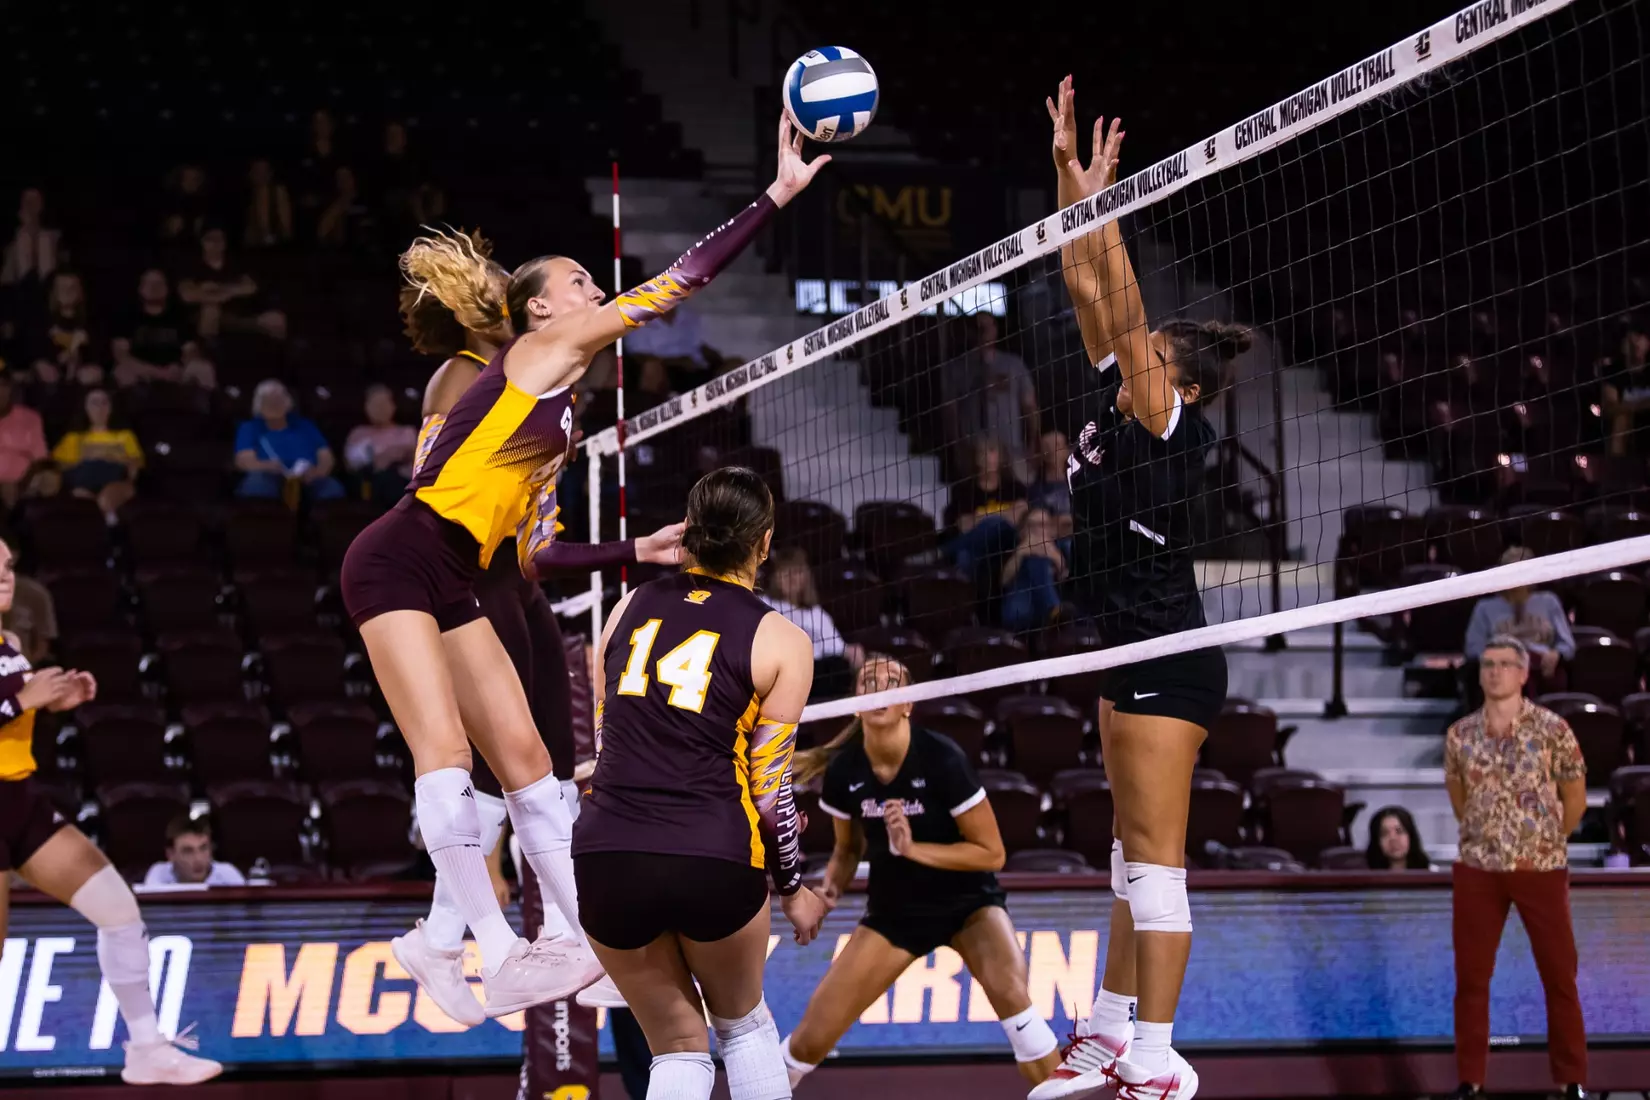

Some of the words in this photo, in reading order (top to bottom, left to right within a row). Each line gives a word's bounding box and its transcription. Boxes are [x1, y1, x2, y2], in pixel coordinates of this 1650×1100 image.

[1455, 0, 1508, 43] CENTRAL
[1235, 112, 1277, 150] CENTRAL
[1280, 80, 1328, 129] MICHIGAN
[1331, 48, 1395, 104] VOLLEYBALL
[1061, 199, 1095, 233] CENTRAL
[1096, 178, 1136, 217] MICHIGAN
[1137, 151, 1188, 198] VOLLEYBALL
[920, 270, 948, 301] CENTRAL
[949, 253, 982, 288] MICHIGAN
[982, 232, 1023, 272] VOLLEYBALL
[617, 619, 721, 713] 14
